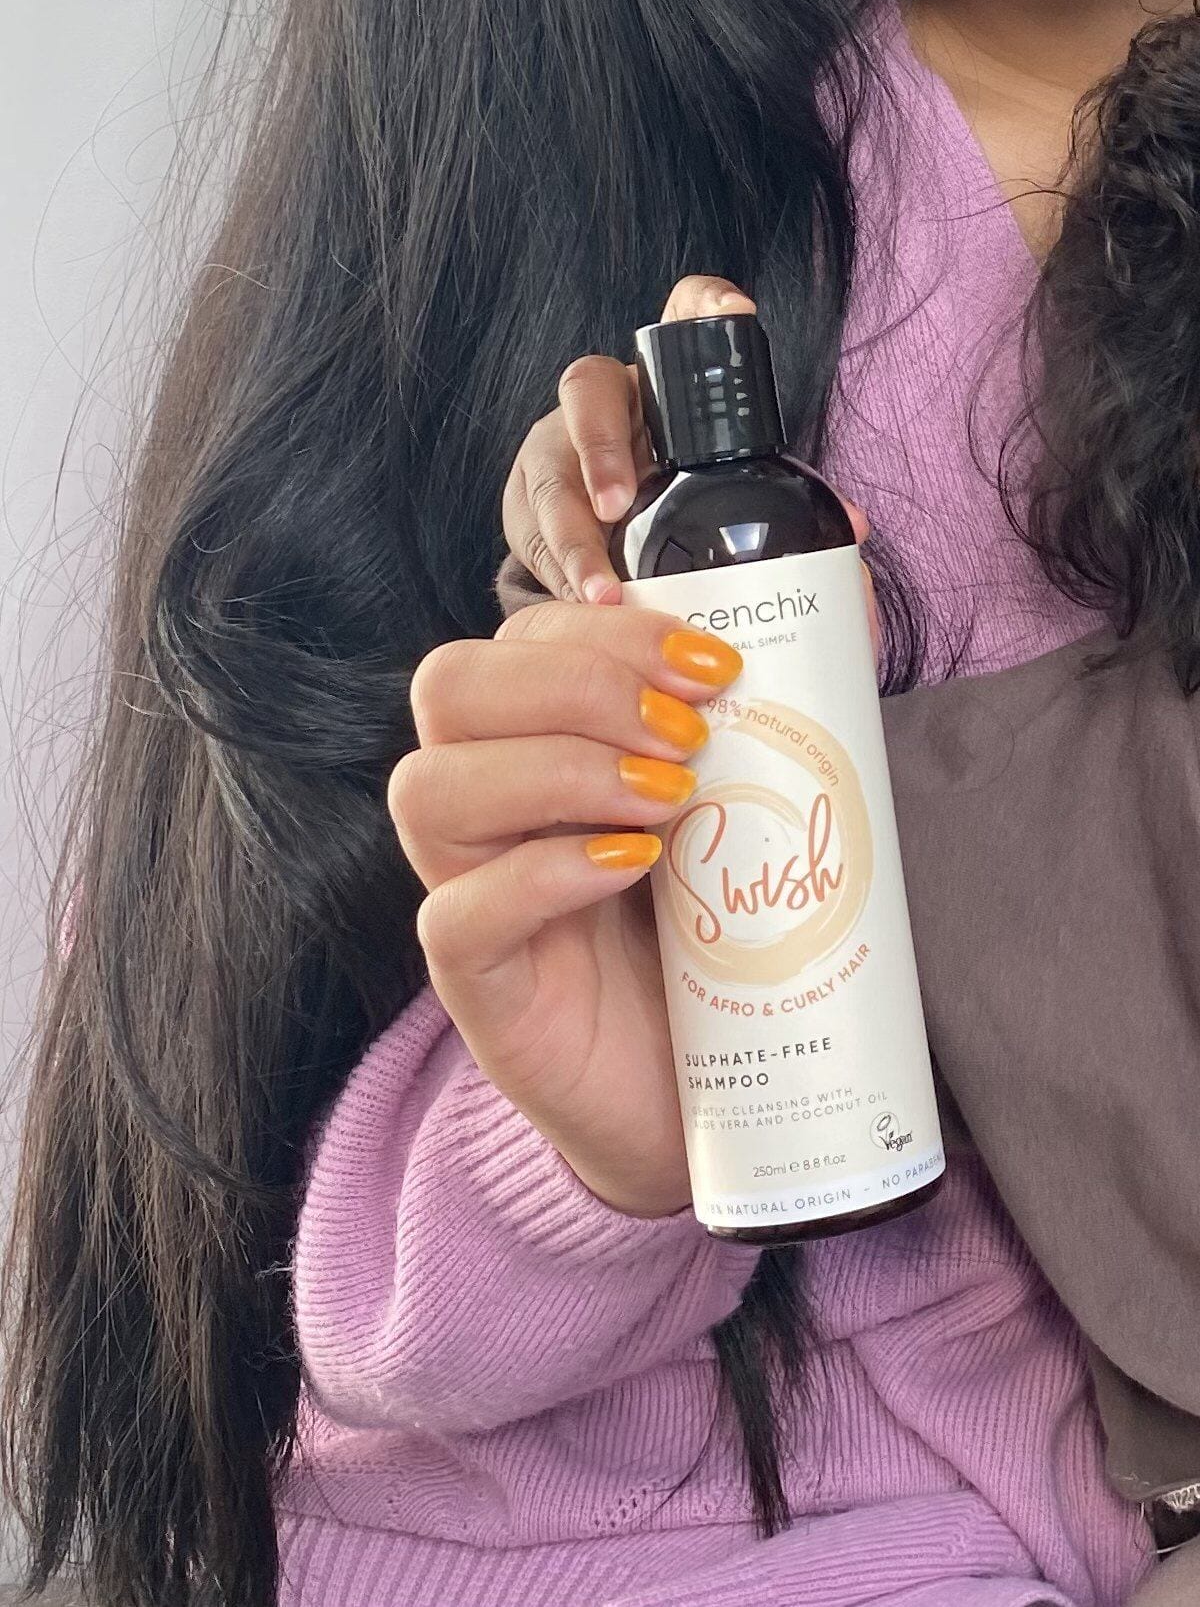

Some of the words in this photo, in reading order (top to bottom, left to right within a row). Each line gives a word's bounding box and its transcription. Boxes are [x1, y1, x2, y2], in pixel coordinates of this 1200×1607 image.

[687, 588, 820, 632] cenchix
[758, 632, 799, 648] SIMPLE
[706, 697, 745, 718] 98%
[746, 707, 809, 748] natural
[805, 743, 841, 788] origin
[667, 793, 844, 945] Swish
[680, 970, 708, 1003] FOR
[709, 994, 756, 1018] AFRO
[761, 1003, 775, 1018] &
[780, 979, 837, 1015] CURLY
[838, 942, 873, 985] HAIR
[684, 1035, 833, 1069] SULPHATE-FREE
[688, 1072, 770, 1091] SHAMPOO
[691, 1105, 726, 1118] GENTLY
[731, 1096, 810, 1116] CLEANSING
[816, 1086, 854, 1104] WITH
[694, 1119, 716, 1131] ALOE
[719, 1118, 750, 1131] VERA
[756, 1114, 785, 1128] AND
[790, 1097, 862, 1123] COCONUT
[867, 1090, 888, 1105] OIL
[878, 1130, 914, 1153] Vegan
[752, 1162, 787, 1179] 250ml
[802, 1157, 822, 1172] 8.8
[727, 1201, 789, 1217] NATURAL
[794, 1188, 852, 1211] ORIGIN
[882, 1172, 902, 1190] NO
